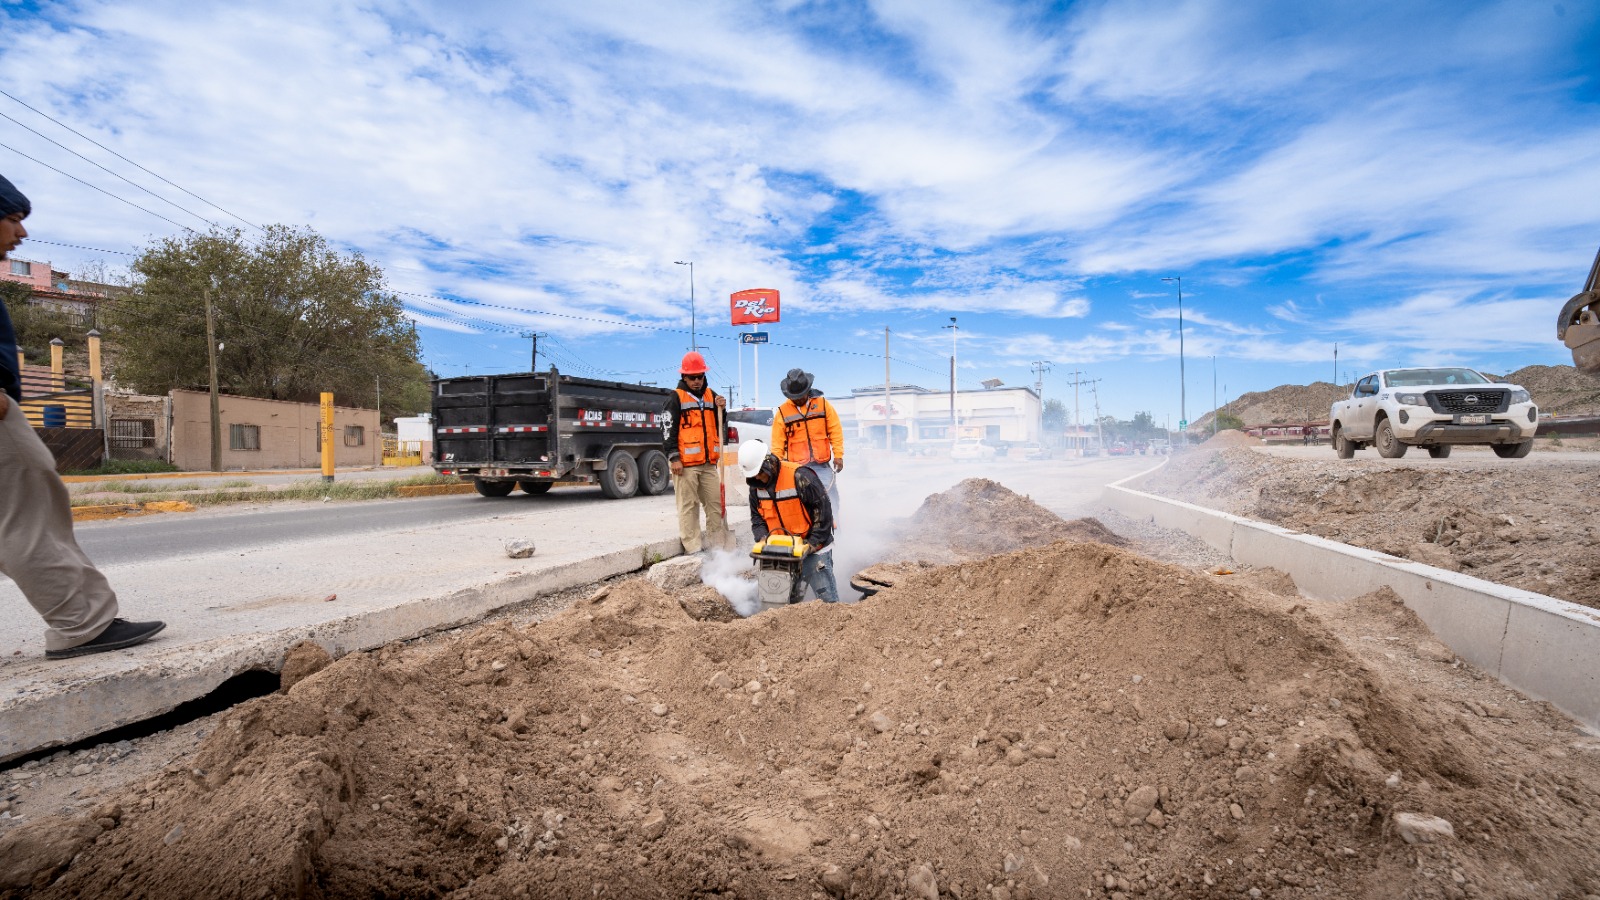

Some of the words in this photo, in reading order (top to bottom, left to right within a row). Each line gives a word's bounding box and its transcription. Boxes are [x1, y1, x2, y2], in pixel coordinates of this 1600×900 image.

[735, 298, 766, 308] Del
[743, 305, 775, 318] Rio
[578, 409, 603, 420] MACIAS
[606, 410, 647, 421] CONSTRUCTION
